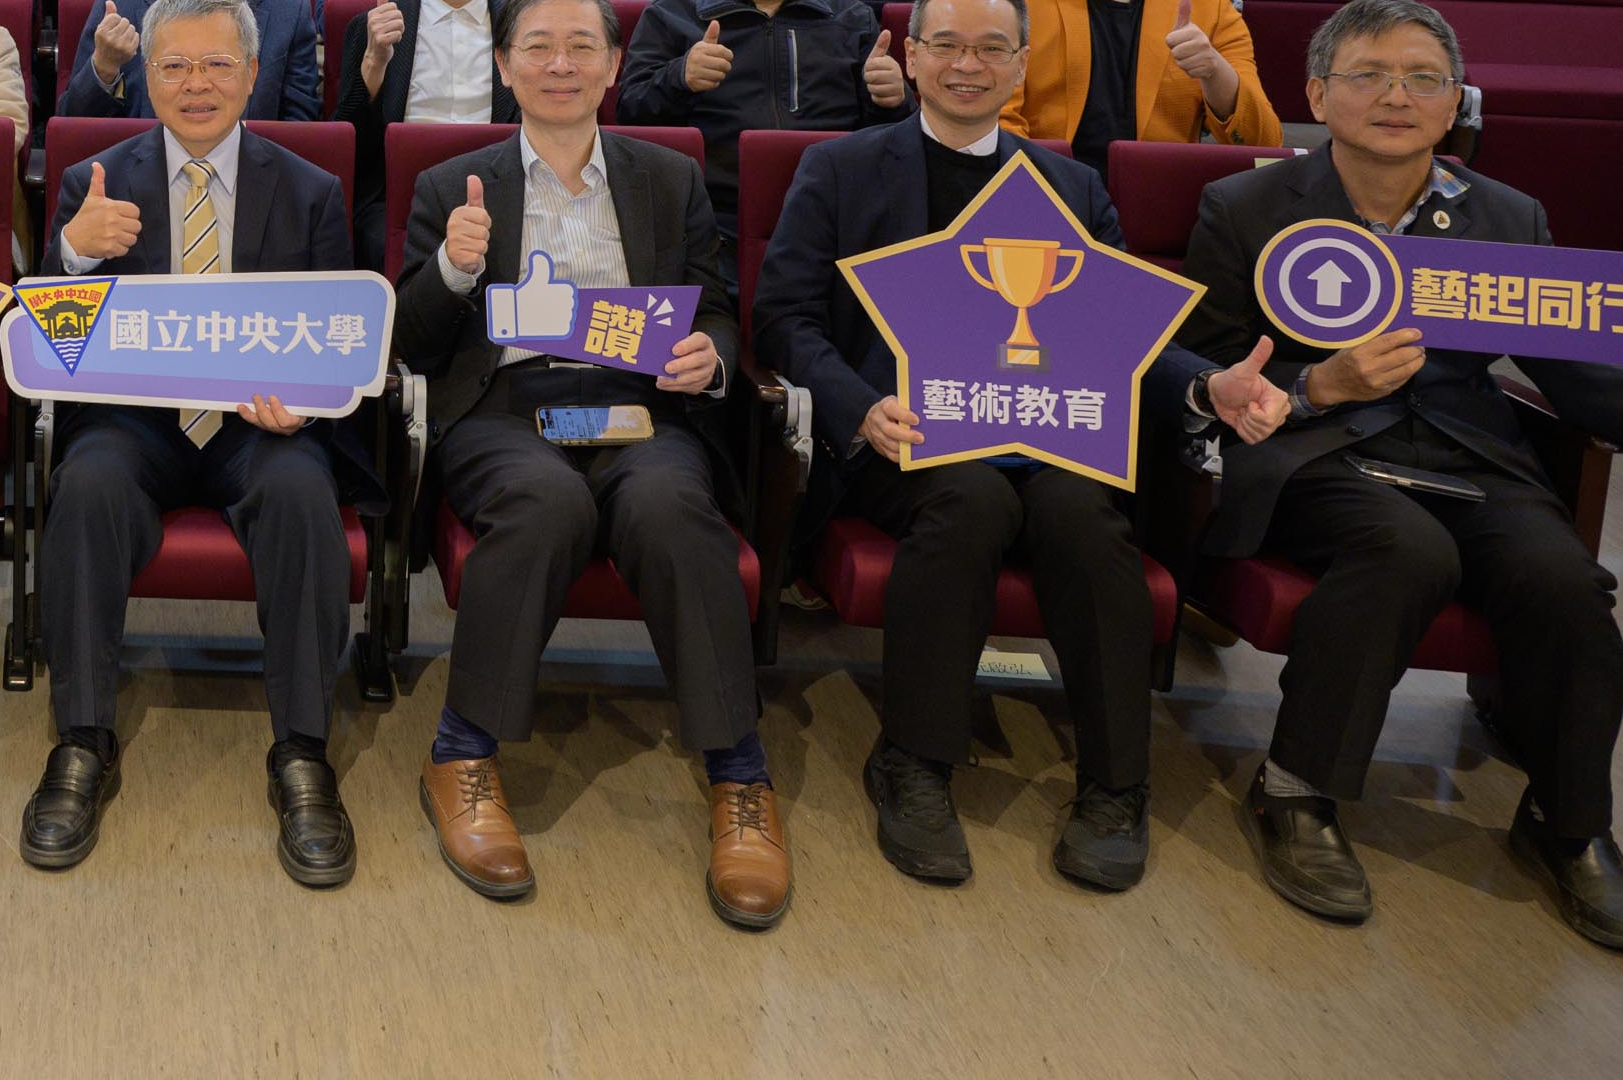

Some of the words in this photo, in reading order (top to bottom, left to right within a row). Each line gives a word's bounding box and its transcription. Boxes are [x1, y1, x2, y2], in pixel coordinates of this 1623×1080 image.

[1410, 267, 1623, 335] 藝起同行
[109, 308, 367, 356] 國立中央大學
[583, 299, 647, 365] 讚
[922, 378, 1107, 431] 藝術教育
